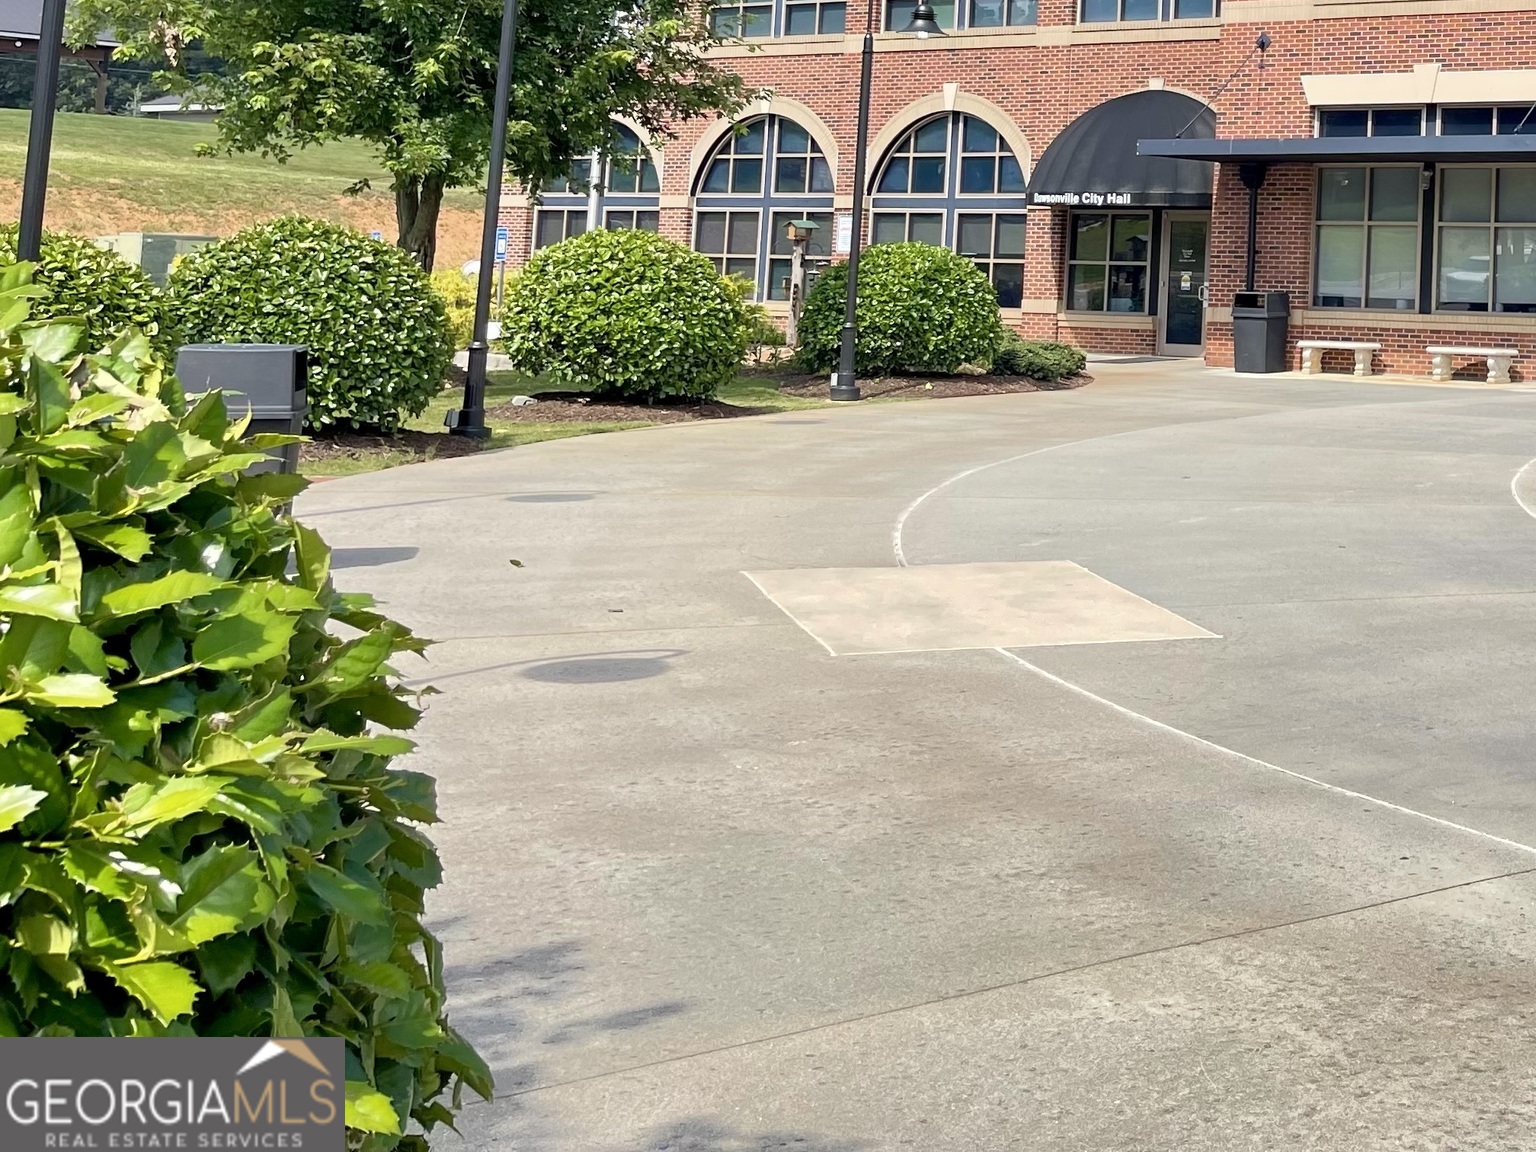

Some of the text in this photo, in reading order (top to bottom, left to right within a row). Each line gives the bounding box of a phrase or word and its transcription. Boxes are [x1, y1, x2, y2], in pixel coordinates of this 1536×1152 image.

[1033, 192, 1131, 206] Dawsonville City Hall
